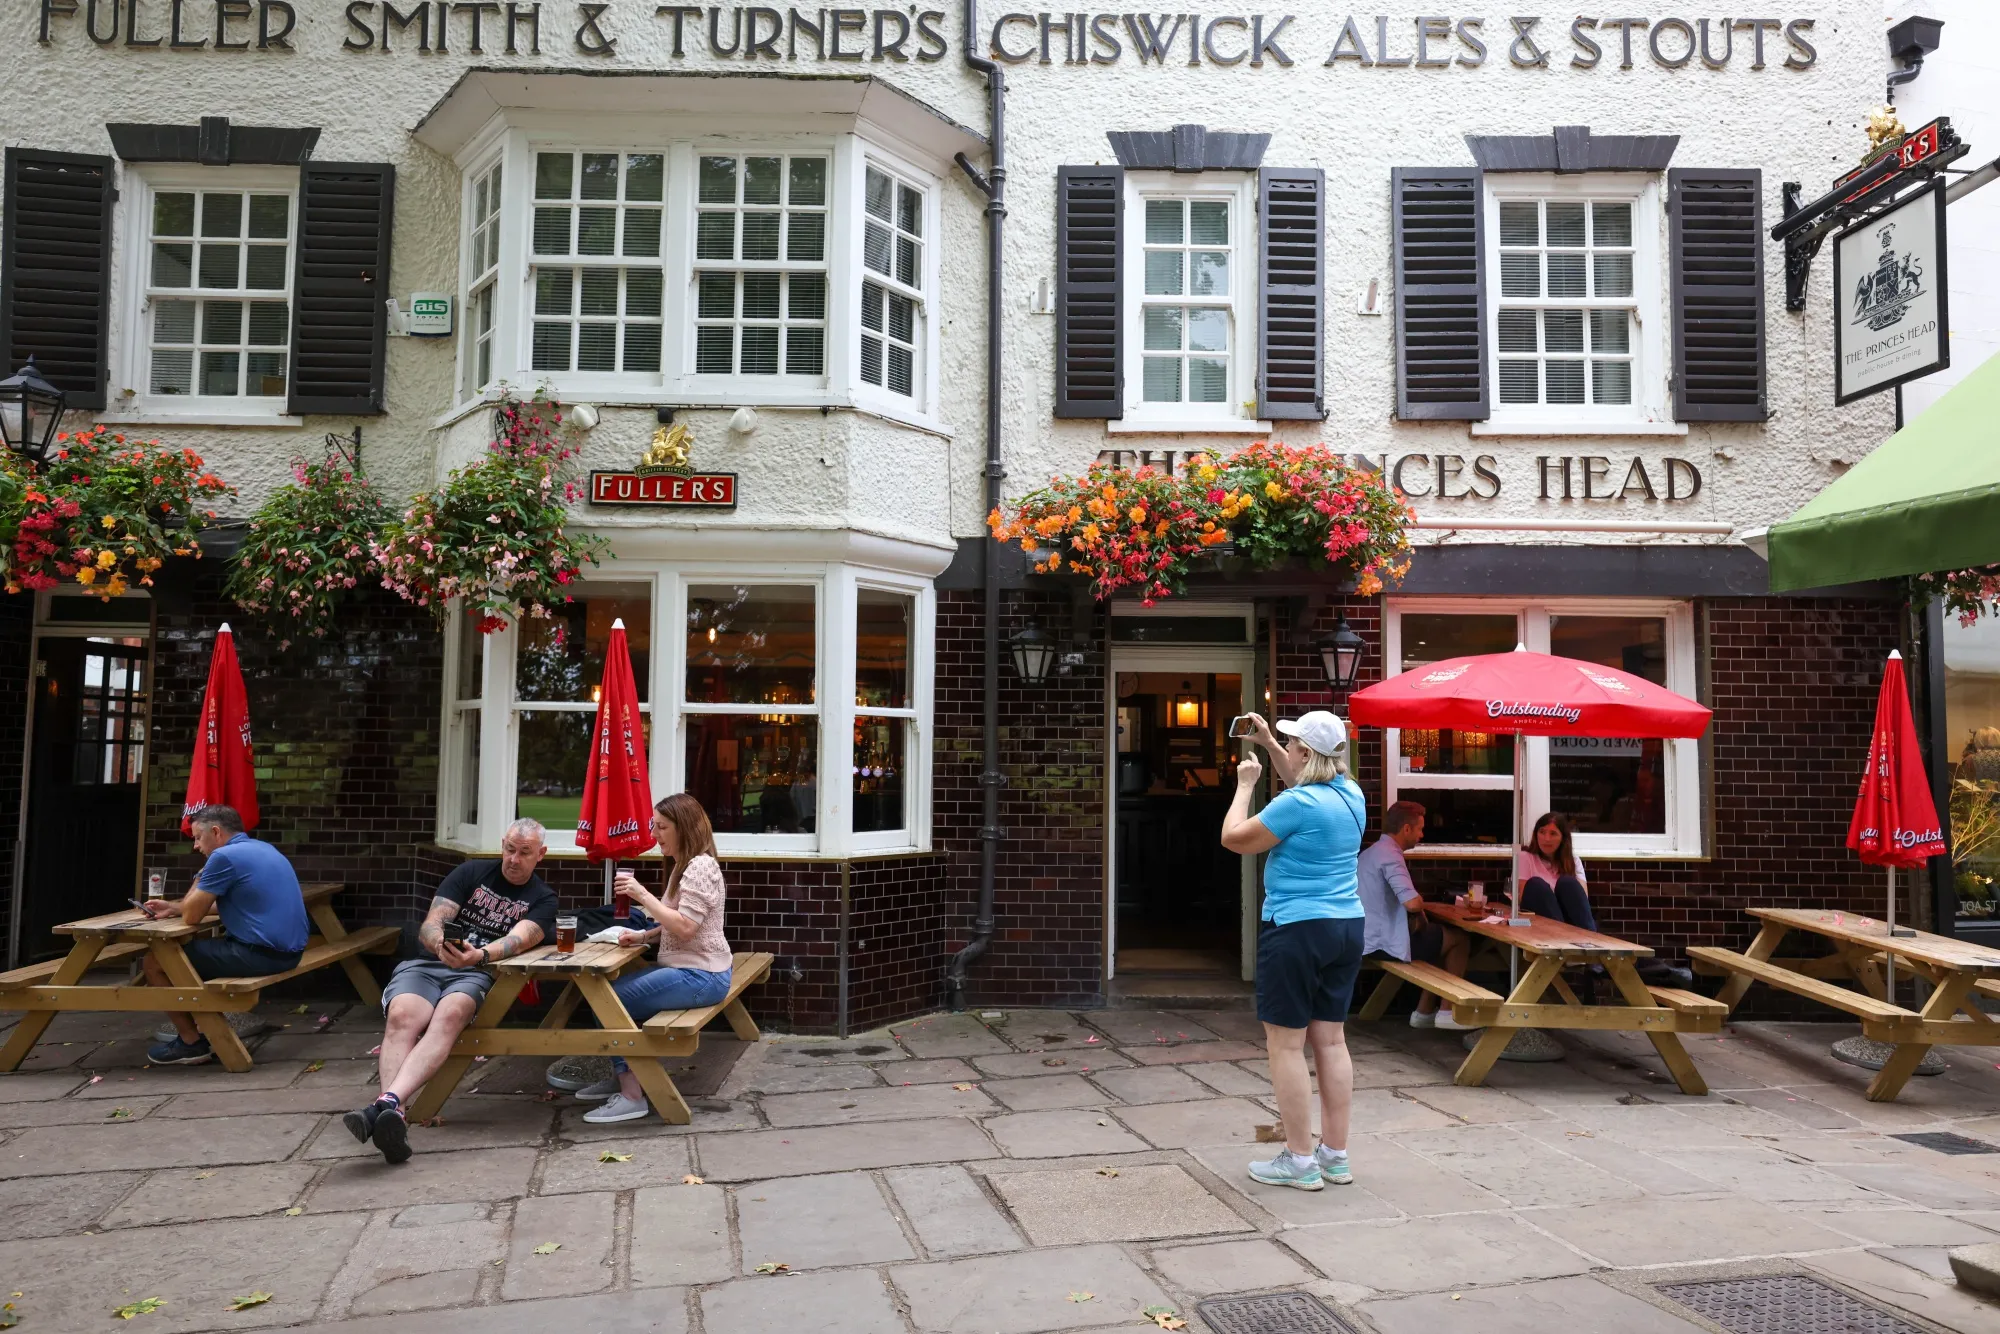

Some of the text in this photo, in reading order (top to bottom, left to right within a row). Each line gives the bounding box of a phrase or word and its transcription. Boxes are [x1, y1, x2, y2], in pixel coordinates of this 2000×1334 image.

[38, 0, 1818, 70] FULLER SMITH & TURNER'S CHISWICK ALES & STOUTS
[1845, 320, 1936, 366] THE PRINCES HEAD
[1857, 367, 1875, 378] public
[1876, 359, 1894, 369] house
[1902, 348, 1921, 360] dining
[600, 476, 725, 501] FULLER'S
[1537, 455, 1702, 501] HEAD
[1486, 700, 1581, 723] Outstanding
[461, 908, 501, 930] CARNEGIE
